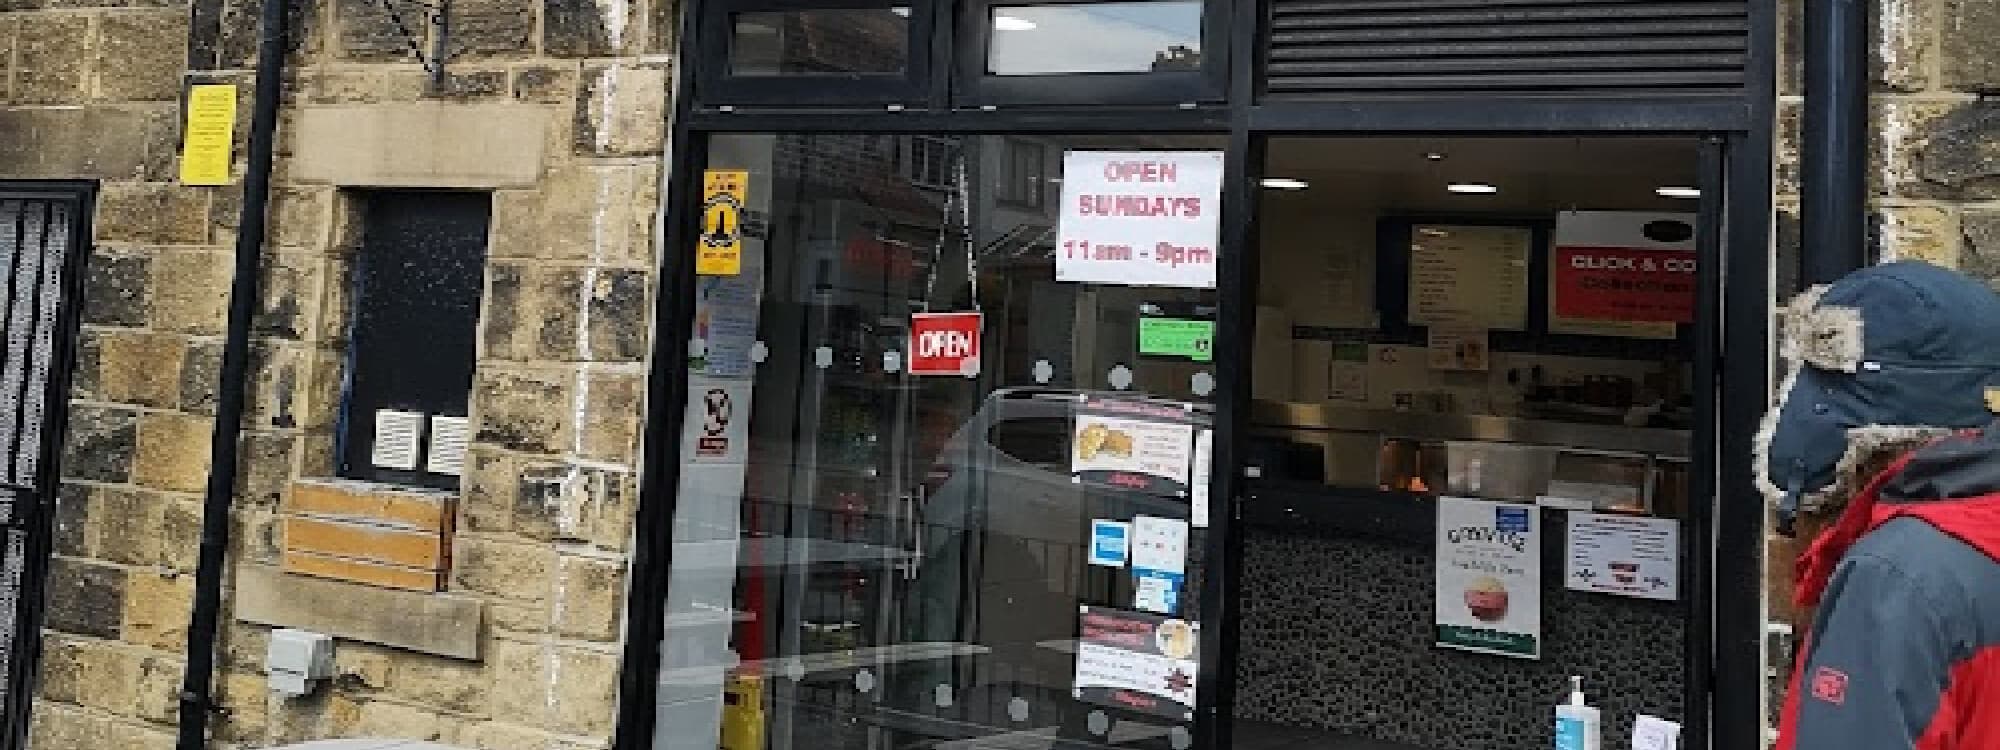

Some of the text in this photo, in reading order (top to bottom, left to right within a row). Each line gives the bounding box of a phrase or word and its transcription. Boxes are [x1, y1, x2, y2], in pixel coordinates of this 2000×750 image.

[1104, 161, 1177, 183] OPEN
[1079, 194, 1201, 218] SUNDAYS
[1064, 240, 1133, 261] 11am
[1155, 241, 1213, 268] 9pm
[1571, 255, 1637, 271] CLICK
[1640, 257, 1657, 272] &
[919, 330, 974, 358] OPEN
